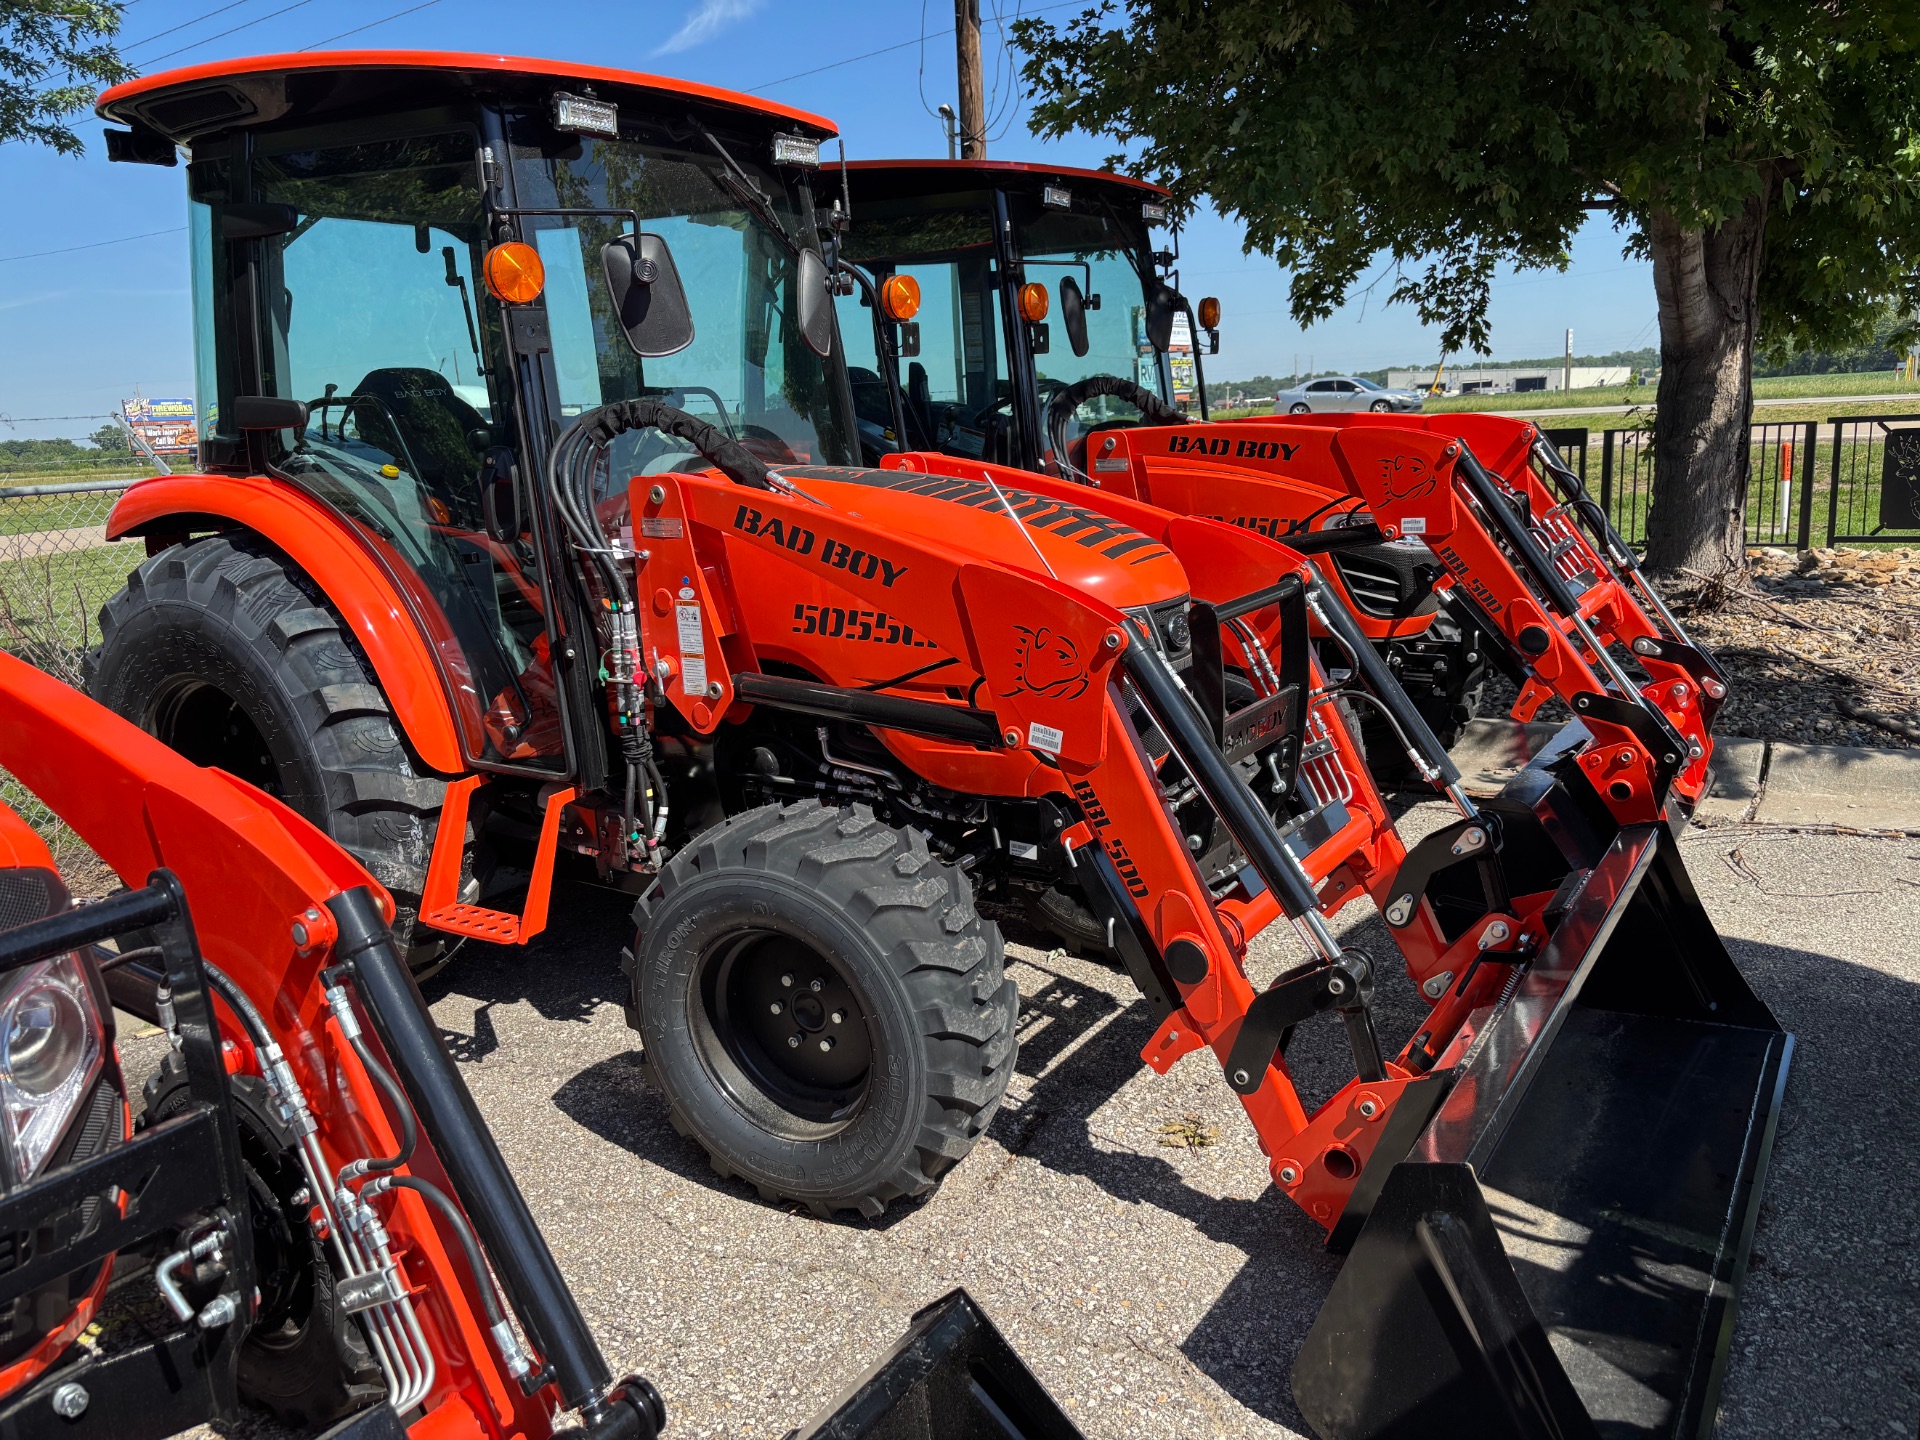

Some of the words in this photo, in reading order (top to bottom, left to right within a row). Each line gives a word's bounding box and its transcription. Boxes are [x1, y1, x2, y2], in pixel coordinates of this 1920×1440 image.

[394, 390, 422, 399] BAD
[424, 388, 447, 397] BOY
[151, 404, 193, 412] FIREWORKS
[147, 429, 162, 437] Work
[162, 428, 182, 437] Injury?
[1168, 435, 1231, 456] BAD
[1235, 440, 1301, 462] BOY
[733, 504, 816, 555] BAD
[820, 538, 909, 588] BOY
[1440, 545, 1470, 581] BBL
[1467, 577, 1503, 614] 500
[1073, 780, 1111, 837] BBL
[1104, 839, 1149, 898] 500
